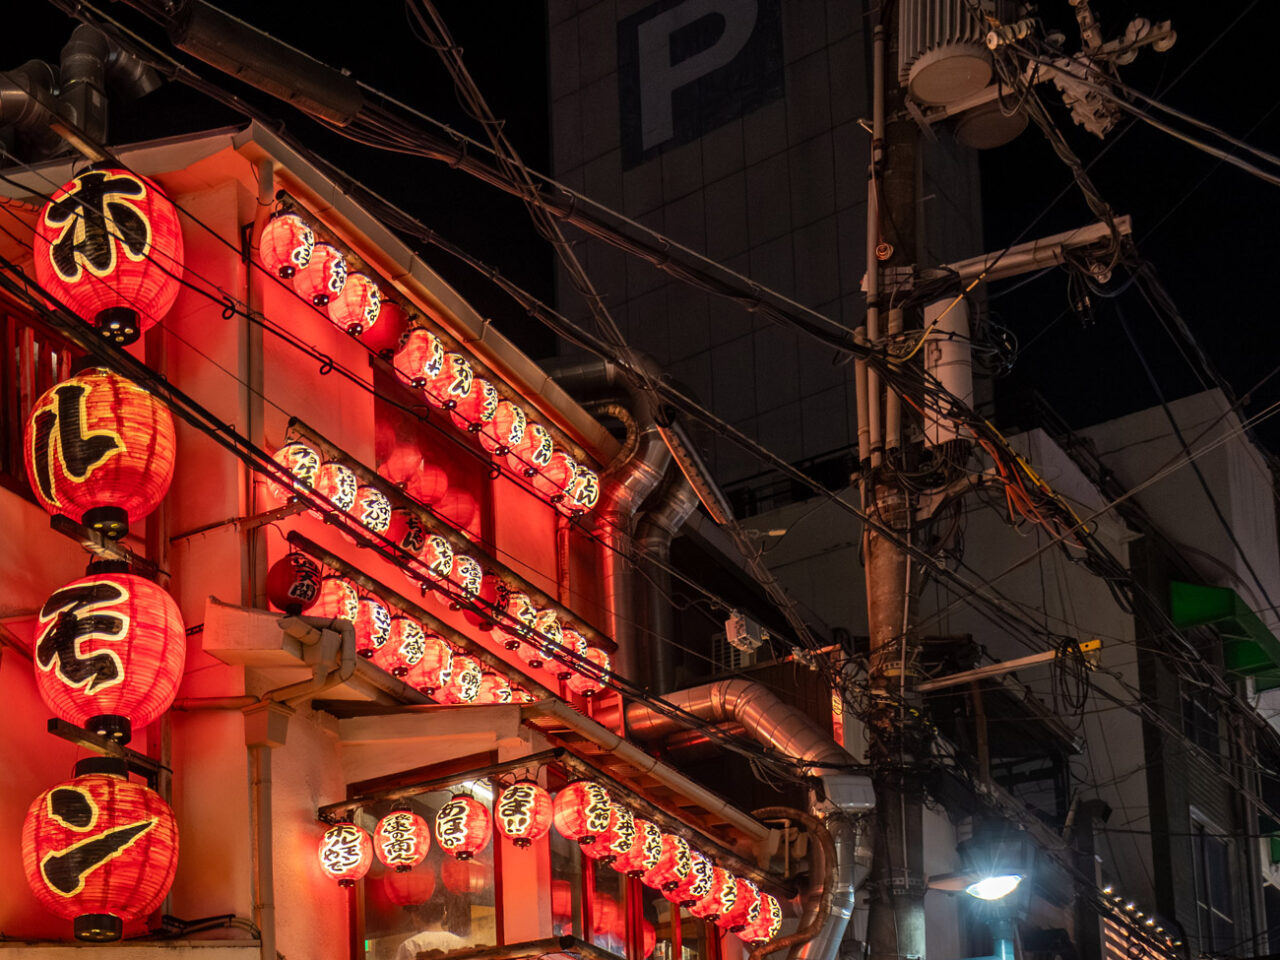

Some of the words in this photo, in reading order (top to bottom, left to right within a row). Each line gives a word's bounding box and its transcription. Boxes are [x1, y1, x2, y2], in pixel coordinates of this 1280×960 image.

[637, 0, 759, 151] P
[436, 800, 468, 848] あほか
